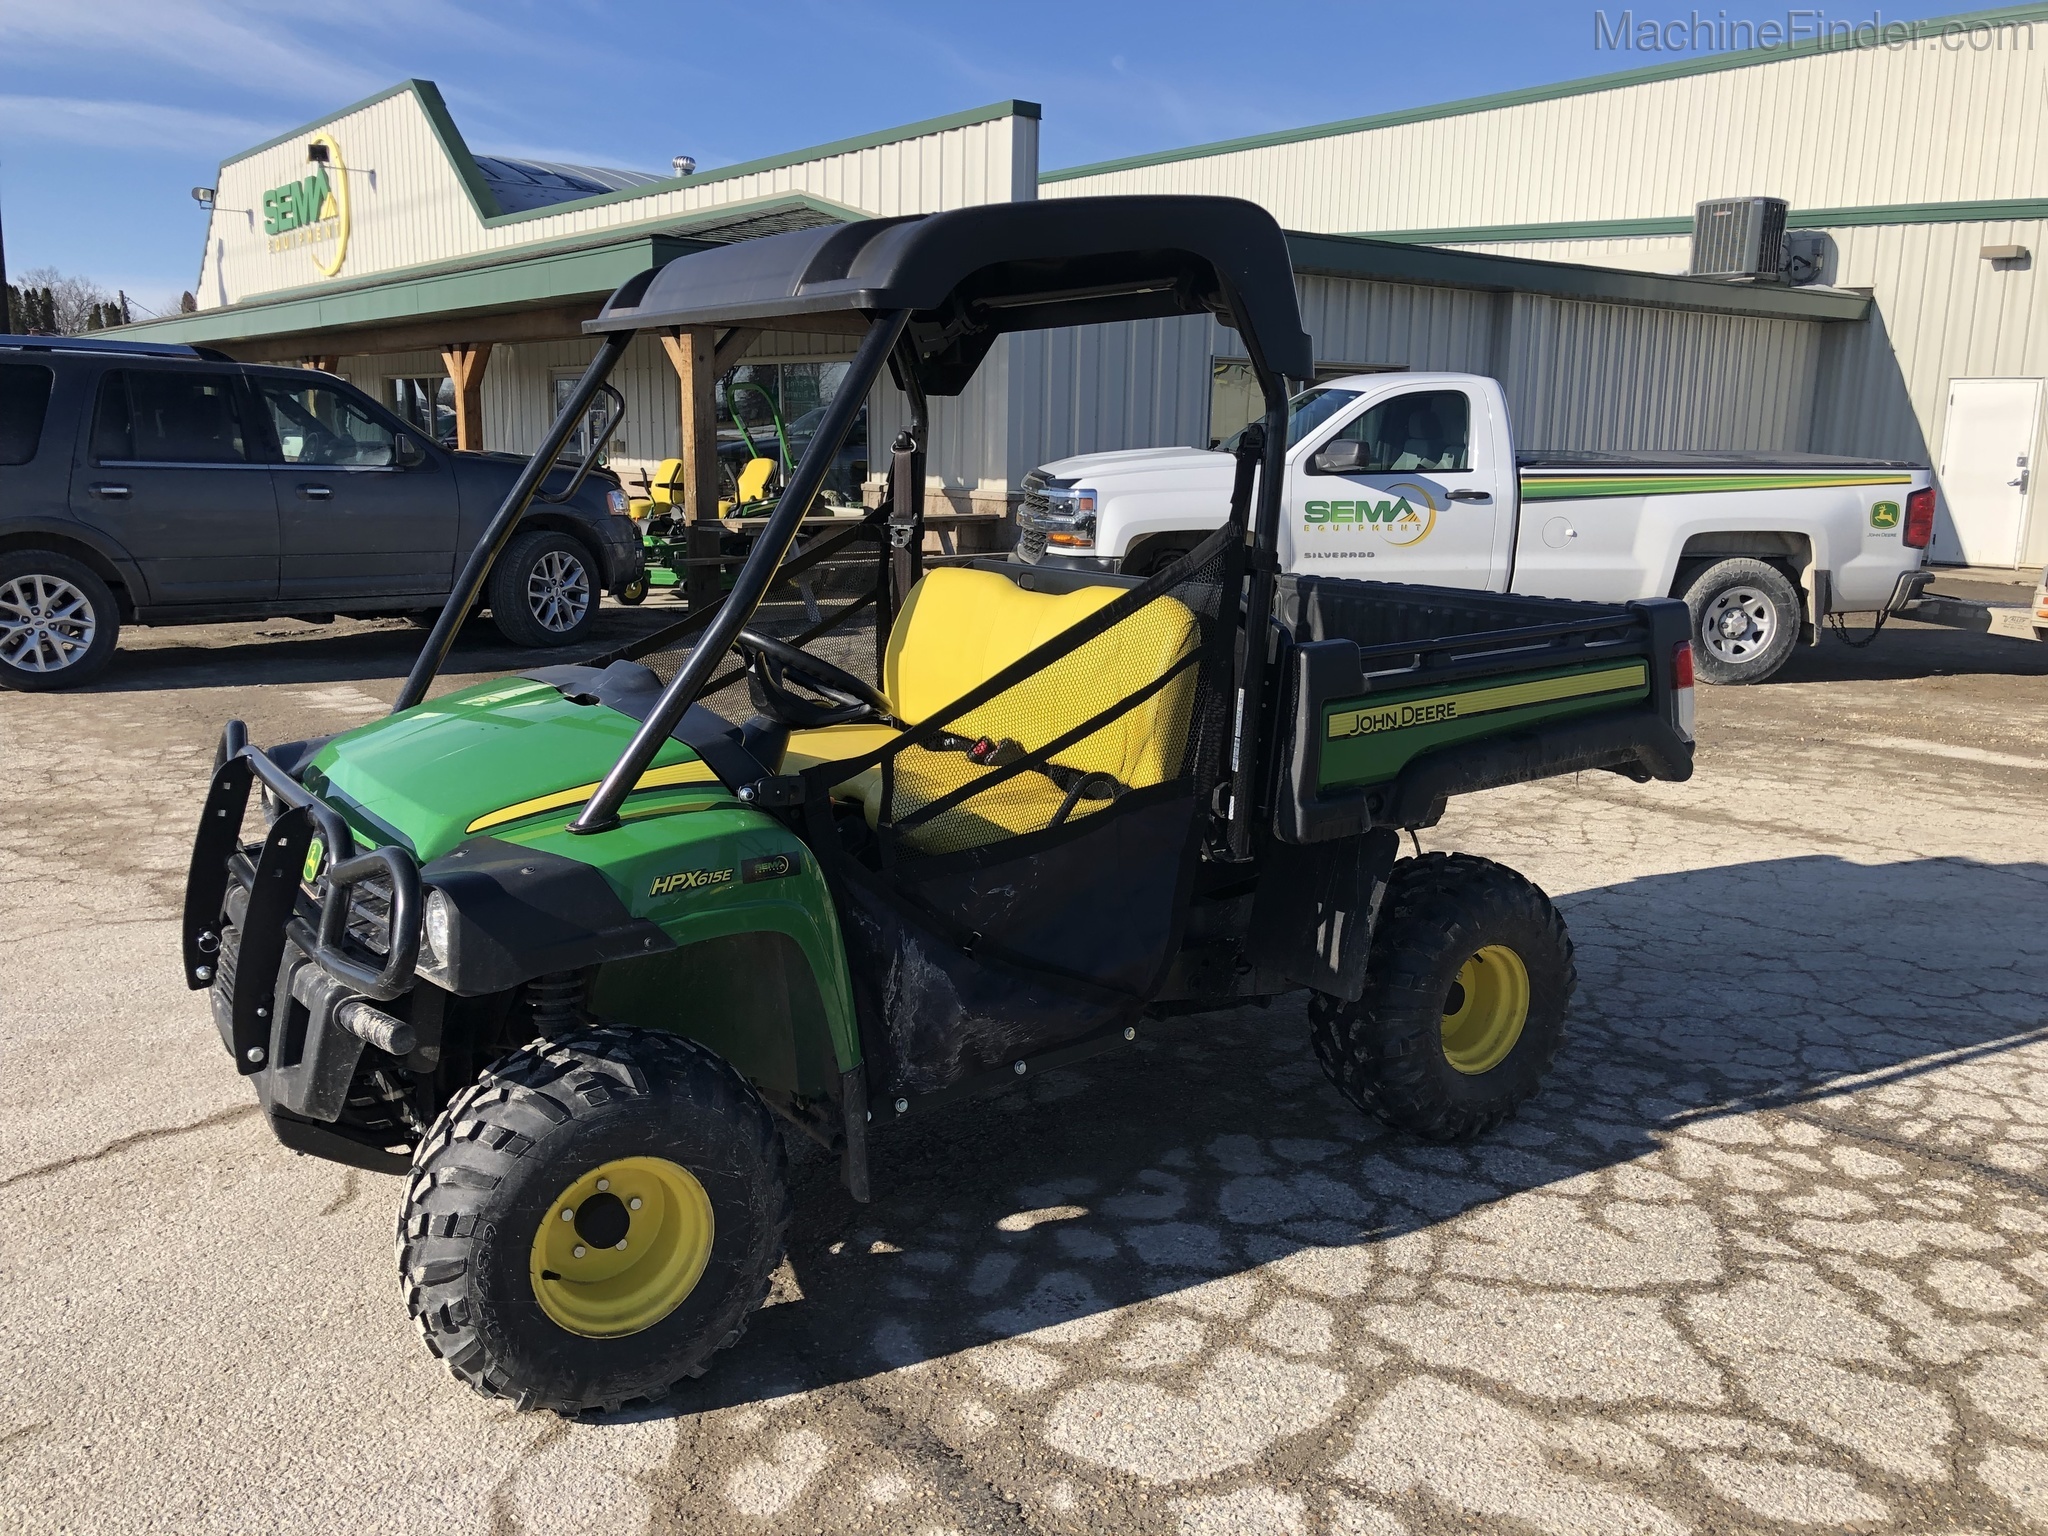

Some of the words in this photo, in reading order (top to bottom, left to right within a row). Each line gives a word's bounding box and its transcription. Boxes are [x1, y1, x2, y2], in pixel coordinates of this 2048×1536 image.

[263, 161, 338, 235] SEMA
[267, 221, 340, 254] EQUIPMENT
[1304, 496, 1421, 523] SEMA
[1303, 524, 1422, 532] EQUIPMENT
[1304, 551, 1375, 559] SILVERADO
[1350, 711, 1398, 734] JOHN
[1402, 702, 1457, 726] DEERE
[650, 868, 734, 896] HPX615E
